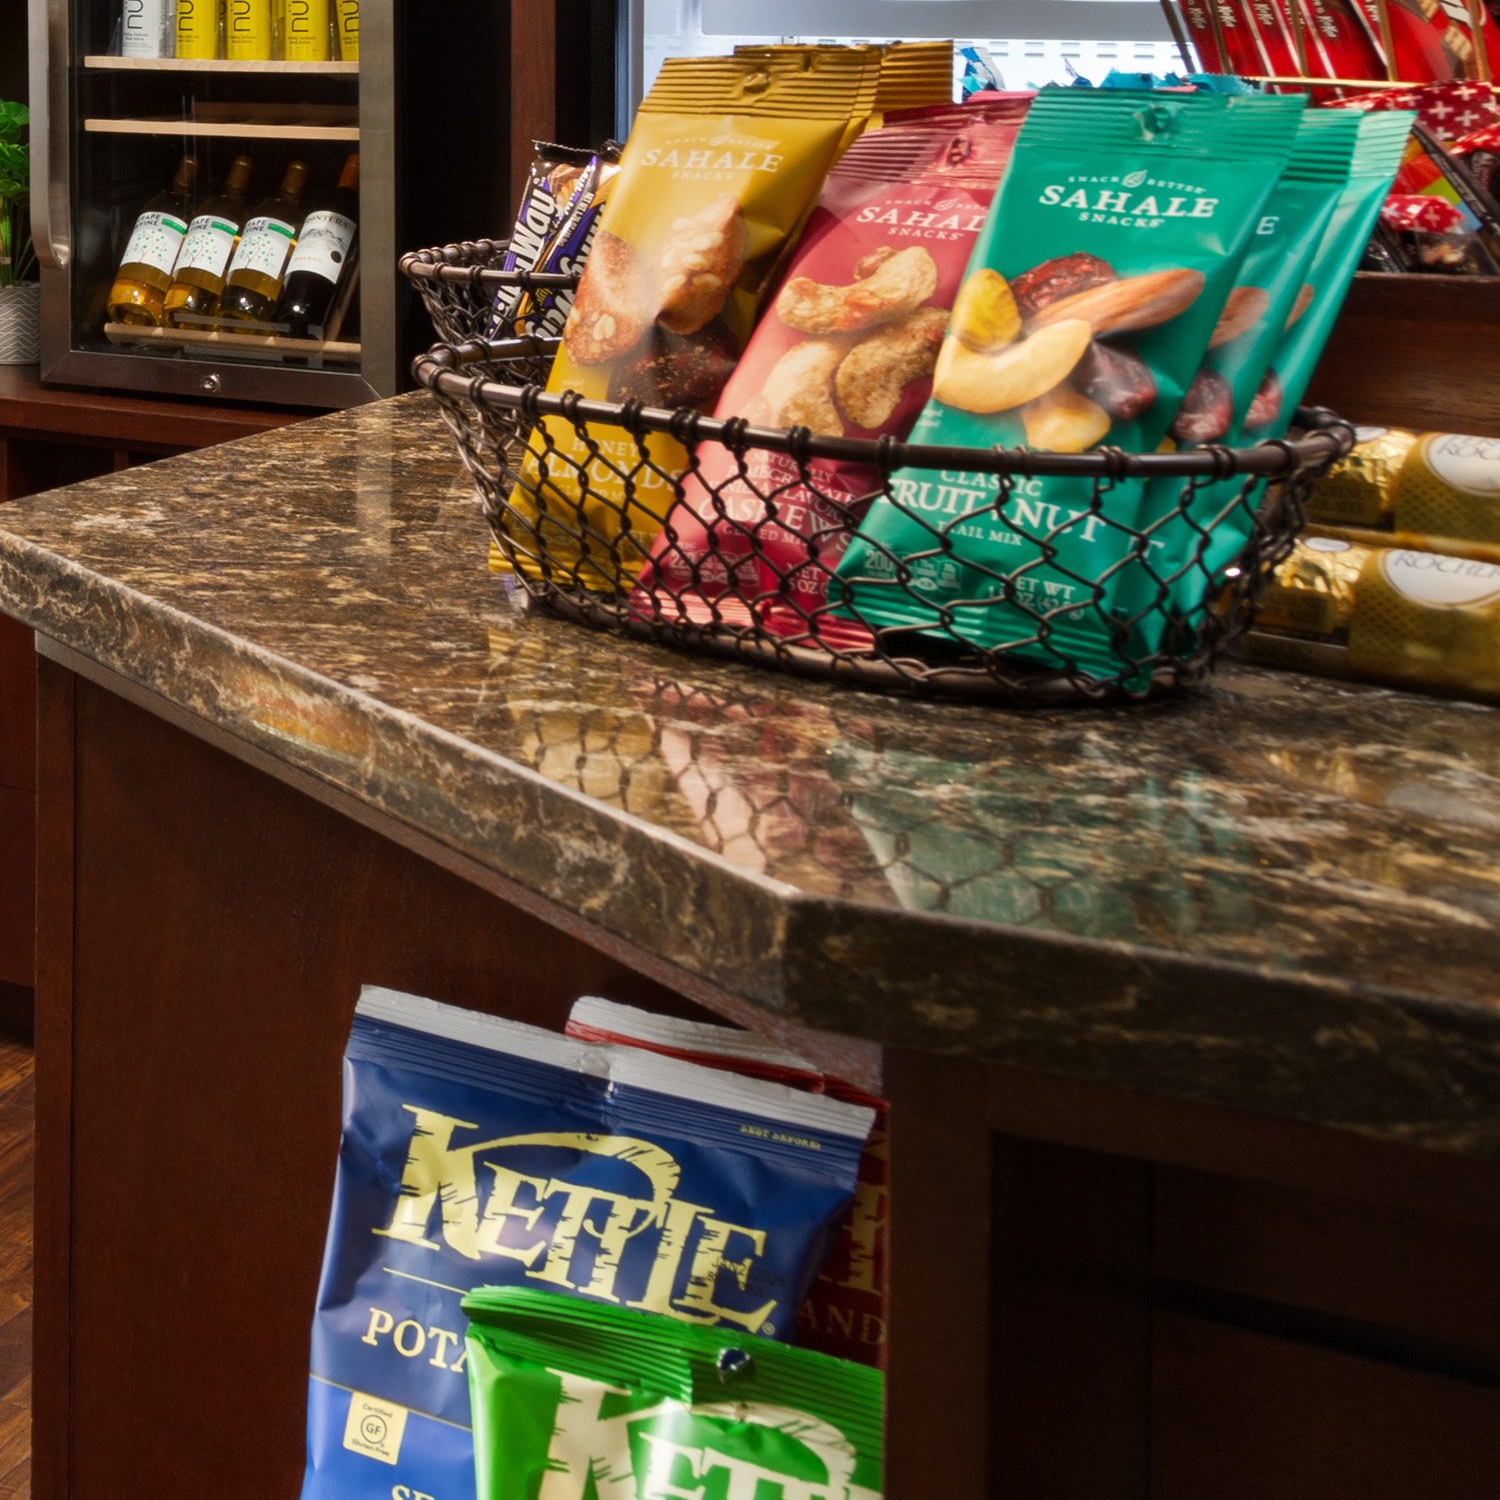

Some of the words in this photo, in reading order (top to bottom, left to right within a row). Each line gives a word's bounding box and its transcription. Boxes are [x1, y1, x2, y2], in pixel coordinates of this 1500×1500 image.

[641, 148, 783, 173] SAHALE
[671, 169, 733, 180] SNACKS
[1069, 175, 1119, 183] SNACK
[1148, 178, 1206, 194] BETTER
[1038, 185, 1219, 219] SAHALE
[857, 206, 987, 231] SAHAL
[1079, 211, 1160, 228] SNACKS
[888, 226, 960, 241] SNACKS
[1010, 498, 1107, 543] NUT
[990, 531, 1022, 546] MIX
[1043, 580, 1076, 600] WT
[371, 1104, 778, 1333] KETTLE
[362, 1403, 393, 1418] Certified
[366, 1423, 381, 1435] GF
[352, 1438, 390, 1457] Gluten-Free
